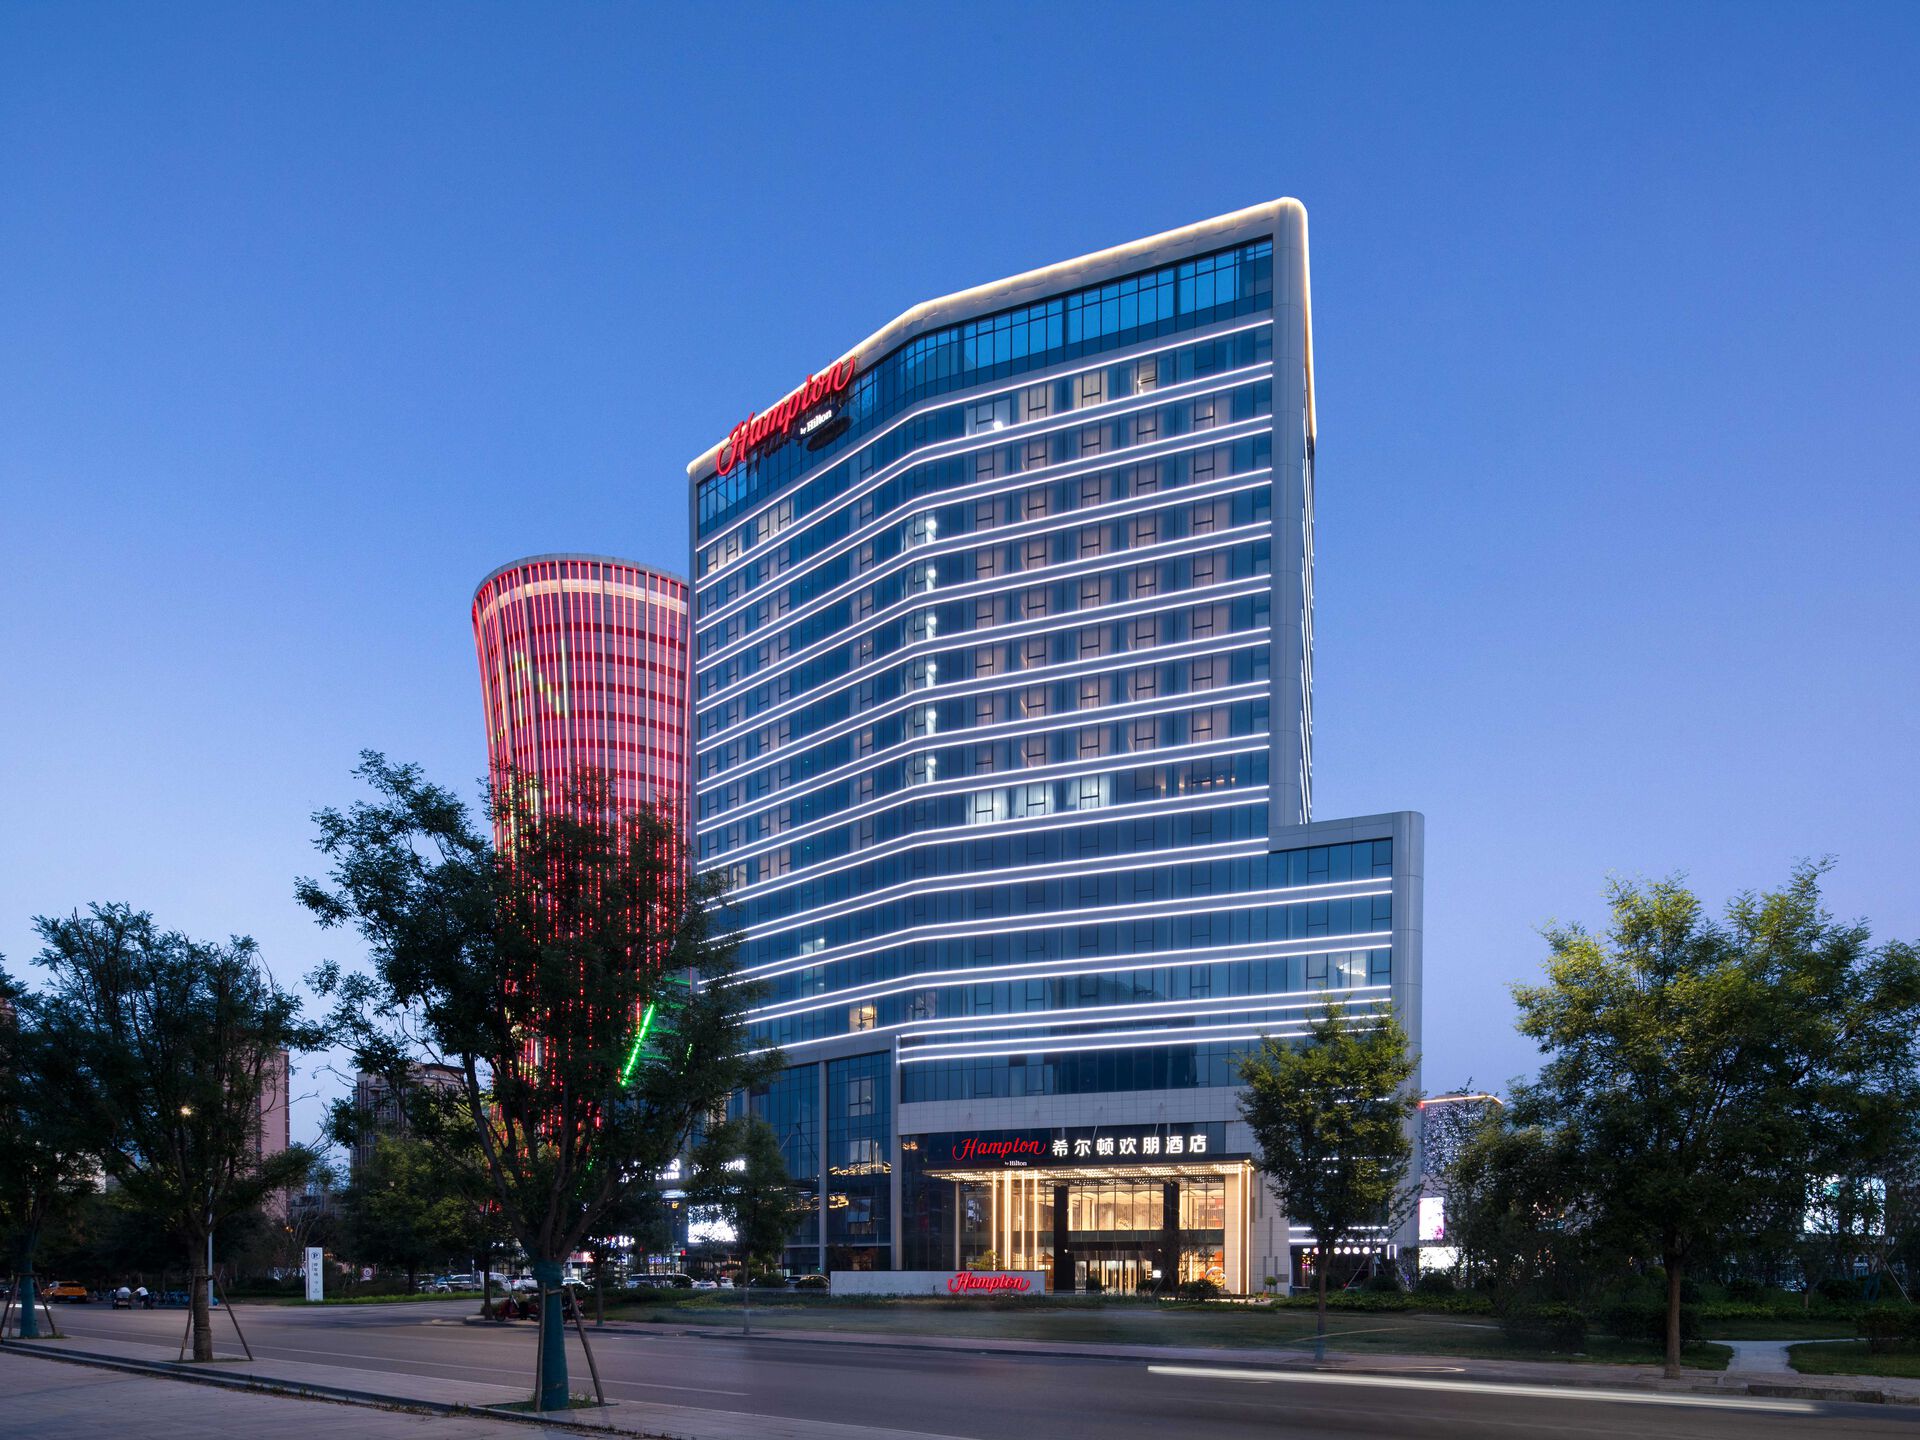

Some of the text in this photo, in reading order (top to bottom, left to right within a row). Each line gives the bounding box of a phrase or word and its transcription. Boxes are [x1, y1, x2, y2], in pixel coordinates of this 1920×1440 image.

[716, 356, 855, 476] Hampton
[807, 409, 832, 433] Hilton
[952, 1137, 1046, 1161] Hampton
[1052, 1134, 1207, 1157] 希尔顿欢朋酒店
[947, 1271, 1030, 1293] Hampton
